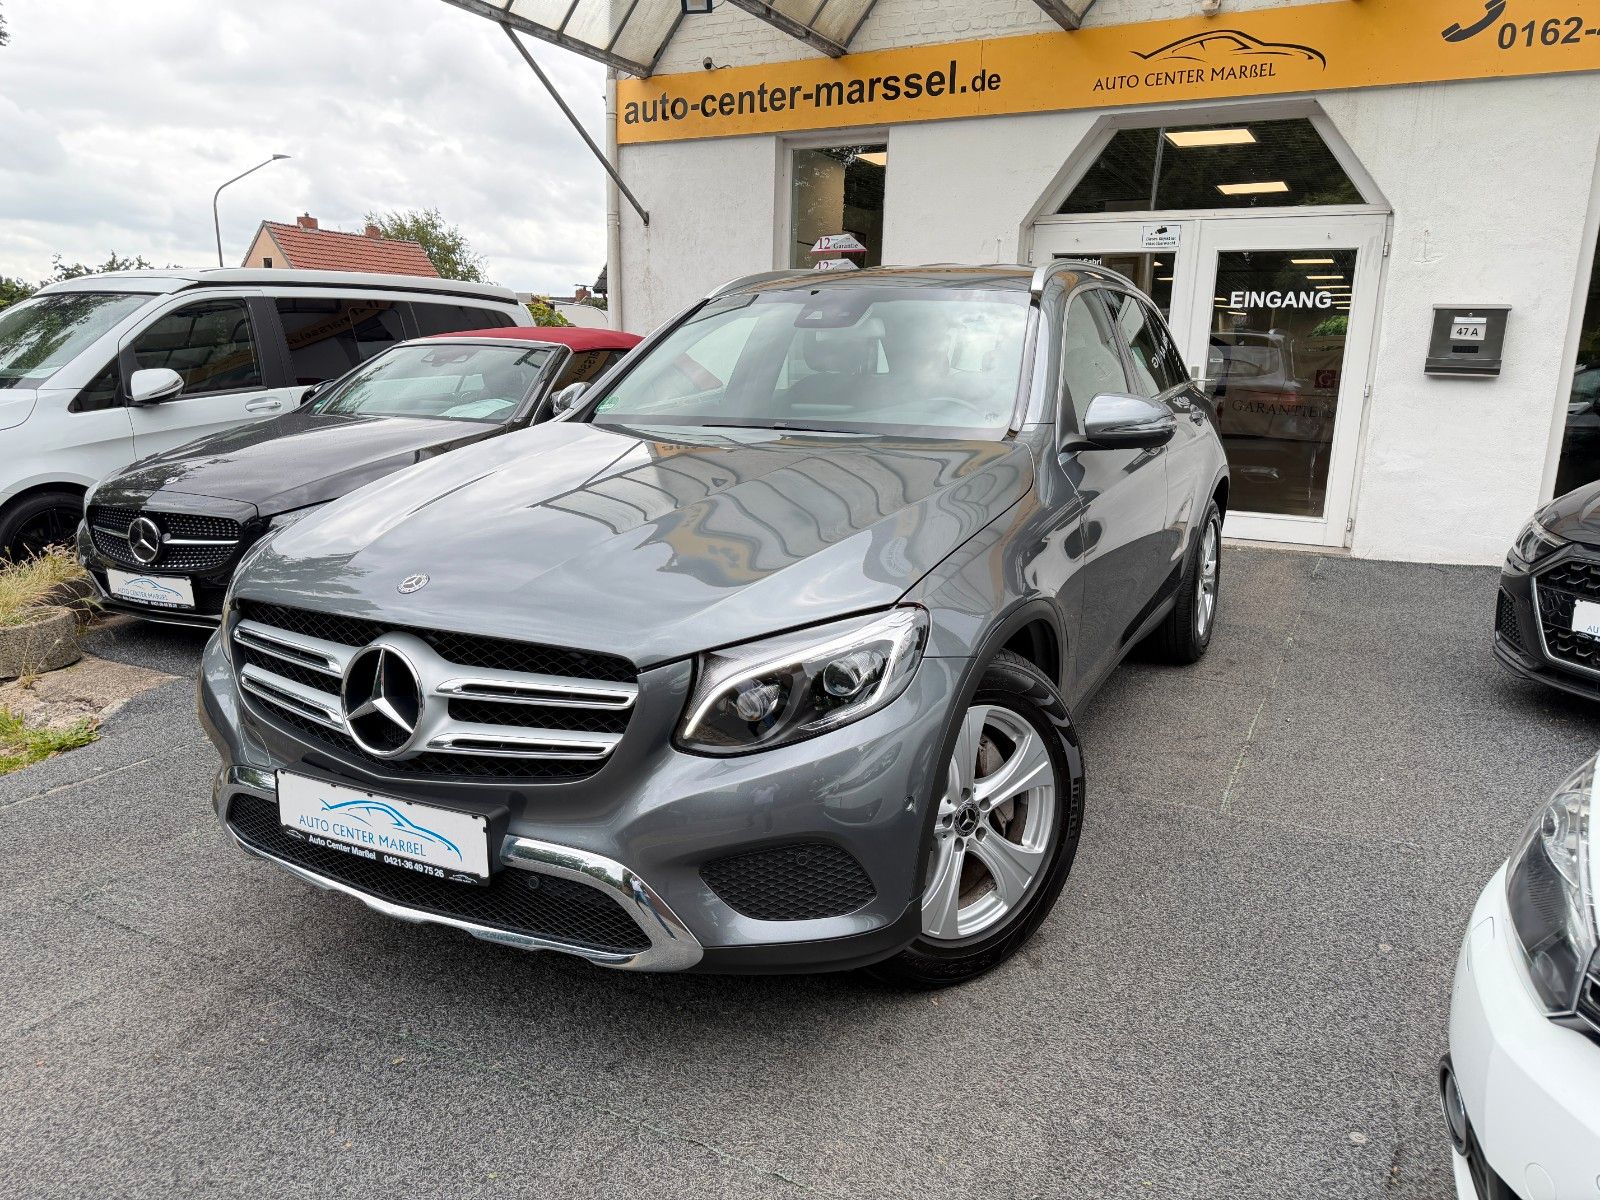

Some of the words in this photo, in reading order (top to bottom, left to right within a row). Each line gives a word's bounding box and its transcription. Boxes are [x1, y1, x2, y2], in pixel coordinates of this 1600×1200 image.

[1497, 15, 1600, 50] 0162-
[1093, 73, 1140, 91] AUTO
[1144, 68, 1205, 87] CENTER
[624, 60, 1002, 126] auto-center-marssel.de
[818, 237, 830, 249] 12
[1230, 291, 1332, 308] EINGANG
[1456, 327, 1469, 336] 47
[1470, 328, 1478, 336] A
[299, 815, 329, 832] AUTO
[333, 824, 374, 843] CENTER
[309, 835, 326, 846] Auto
[327, 840, 351, 853] Center
[384, 855, 414, 869] 0421-36
[413, 863, 424, 873] 49
[424, 865, 434, 876] 75
[434, 867, 445, 878] 26
